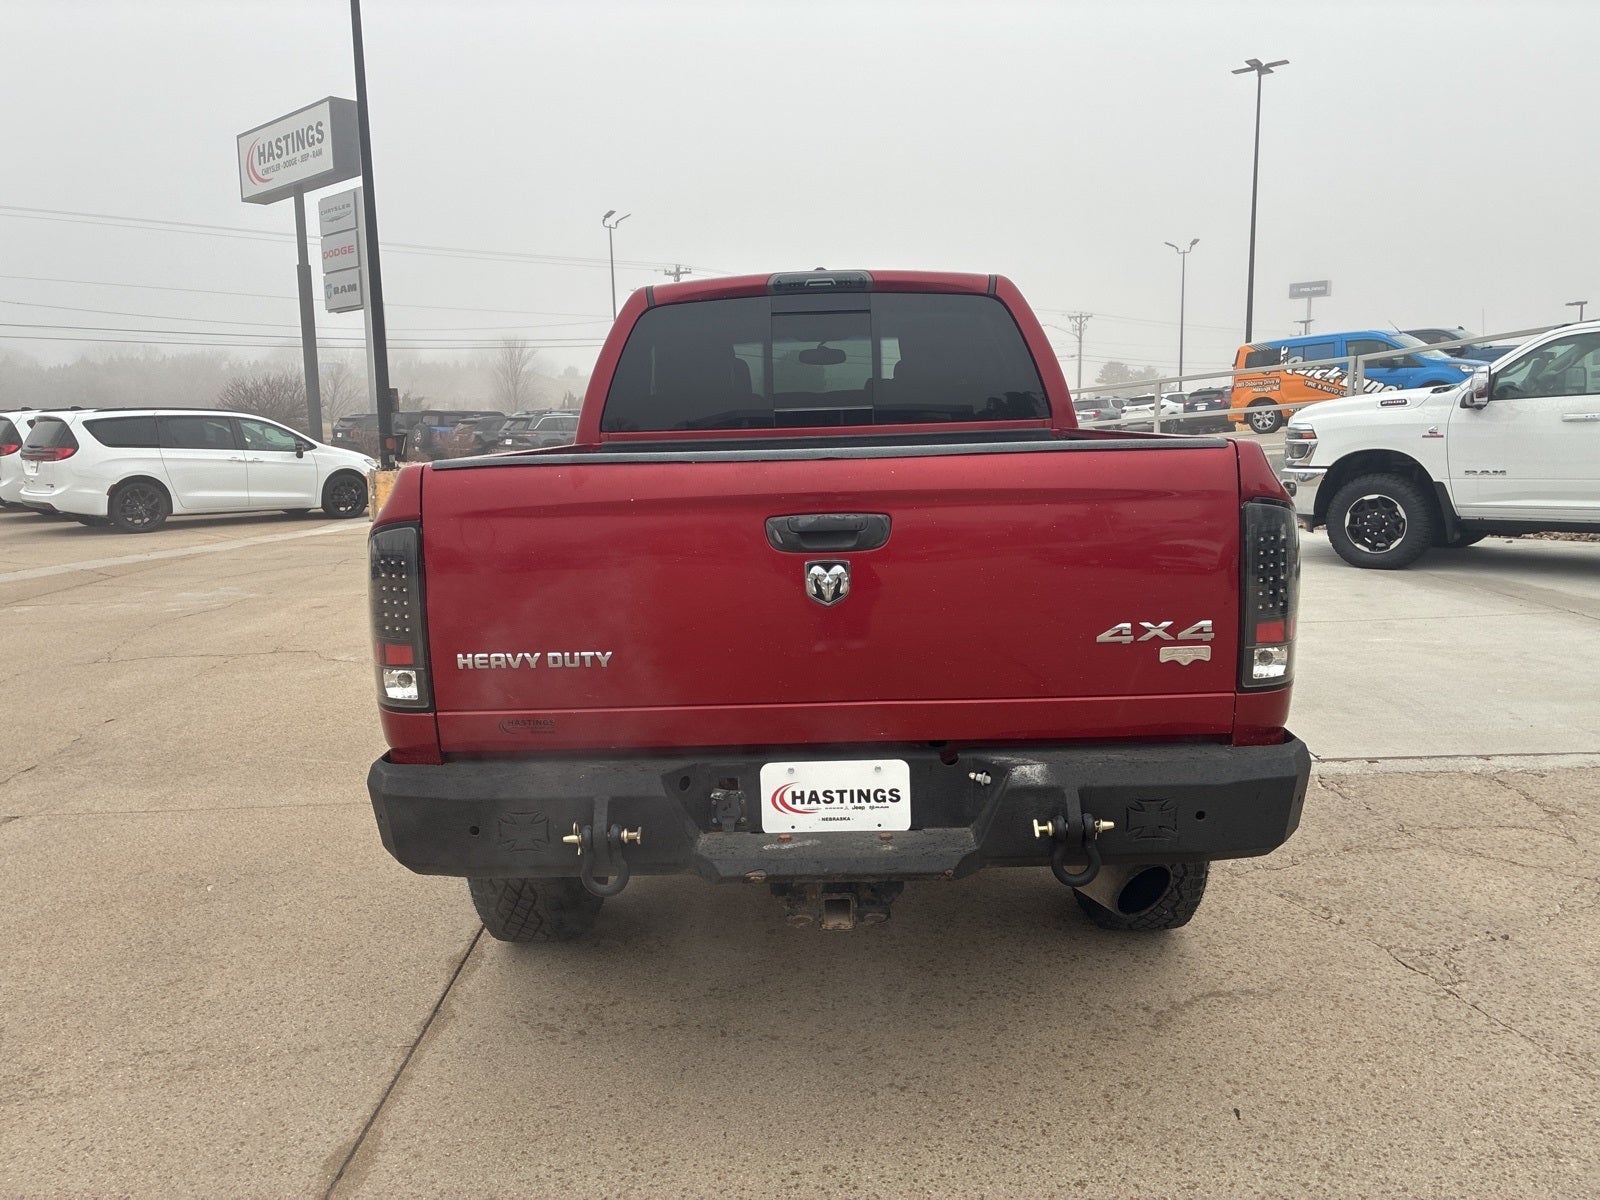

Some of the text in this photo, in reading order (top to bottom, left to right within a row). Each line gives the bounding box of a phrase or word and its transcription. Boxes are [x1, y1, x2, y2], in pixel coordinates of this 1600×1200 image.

[257, 121, 325, 166] HASTINGS
[261, 147, 323, 176] CHRYSLER DODGE JEEP RAM
[320, 203, 351, 216] CHRYSLER
[323, 245, 355, 260] DODGE
[333, 283, 357, 295] RAM
[1304, 380, 1317, 389] TIRE
[1322, 386, 1339, 395] AUTO
[456, 651, 613, 670] HEAVY DUTY
[507, 719, 555, 727] HASTINGS
[790, 787, 901, 805] HASTINGS
